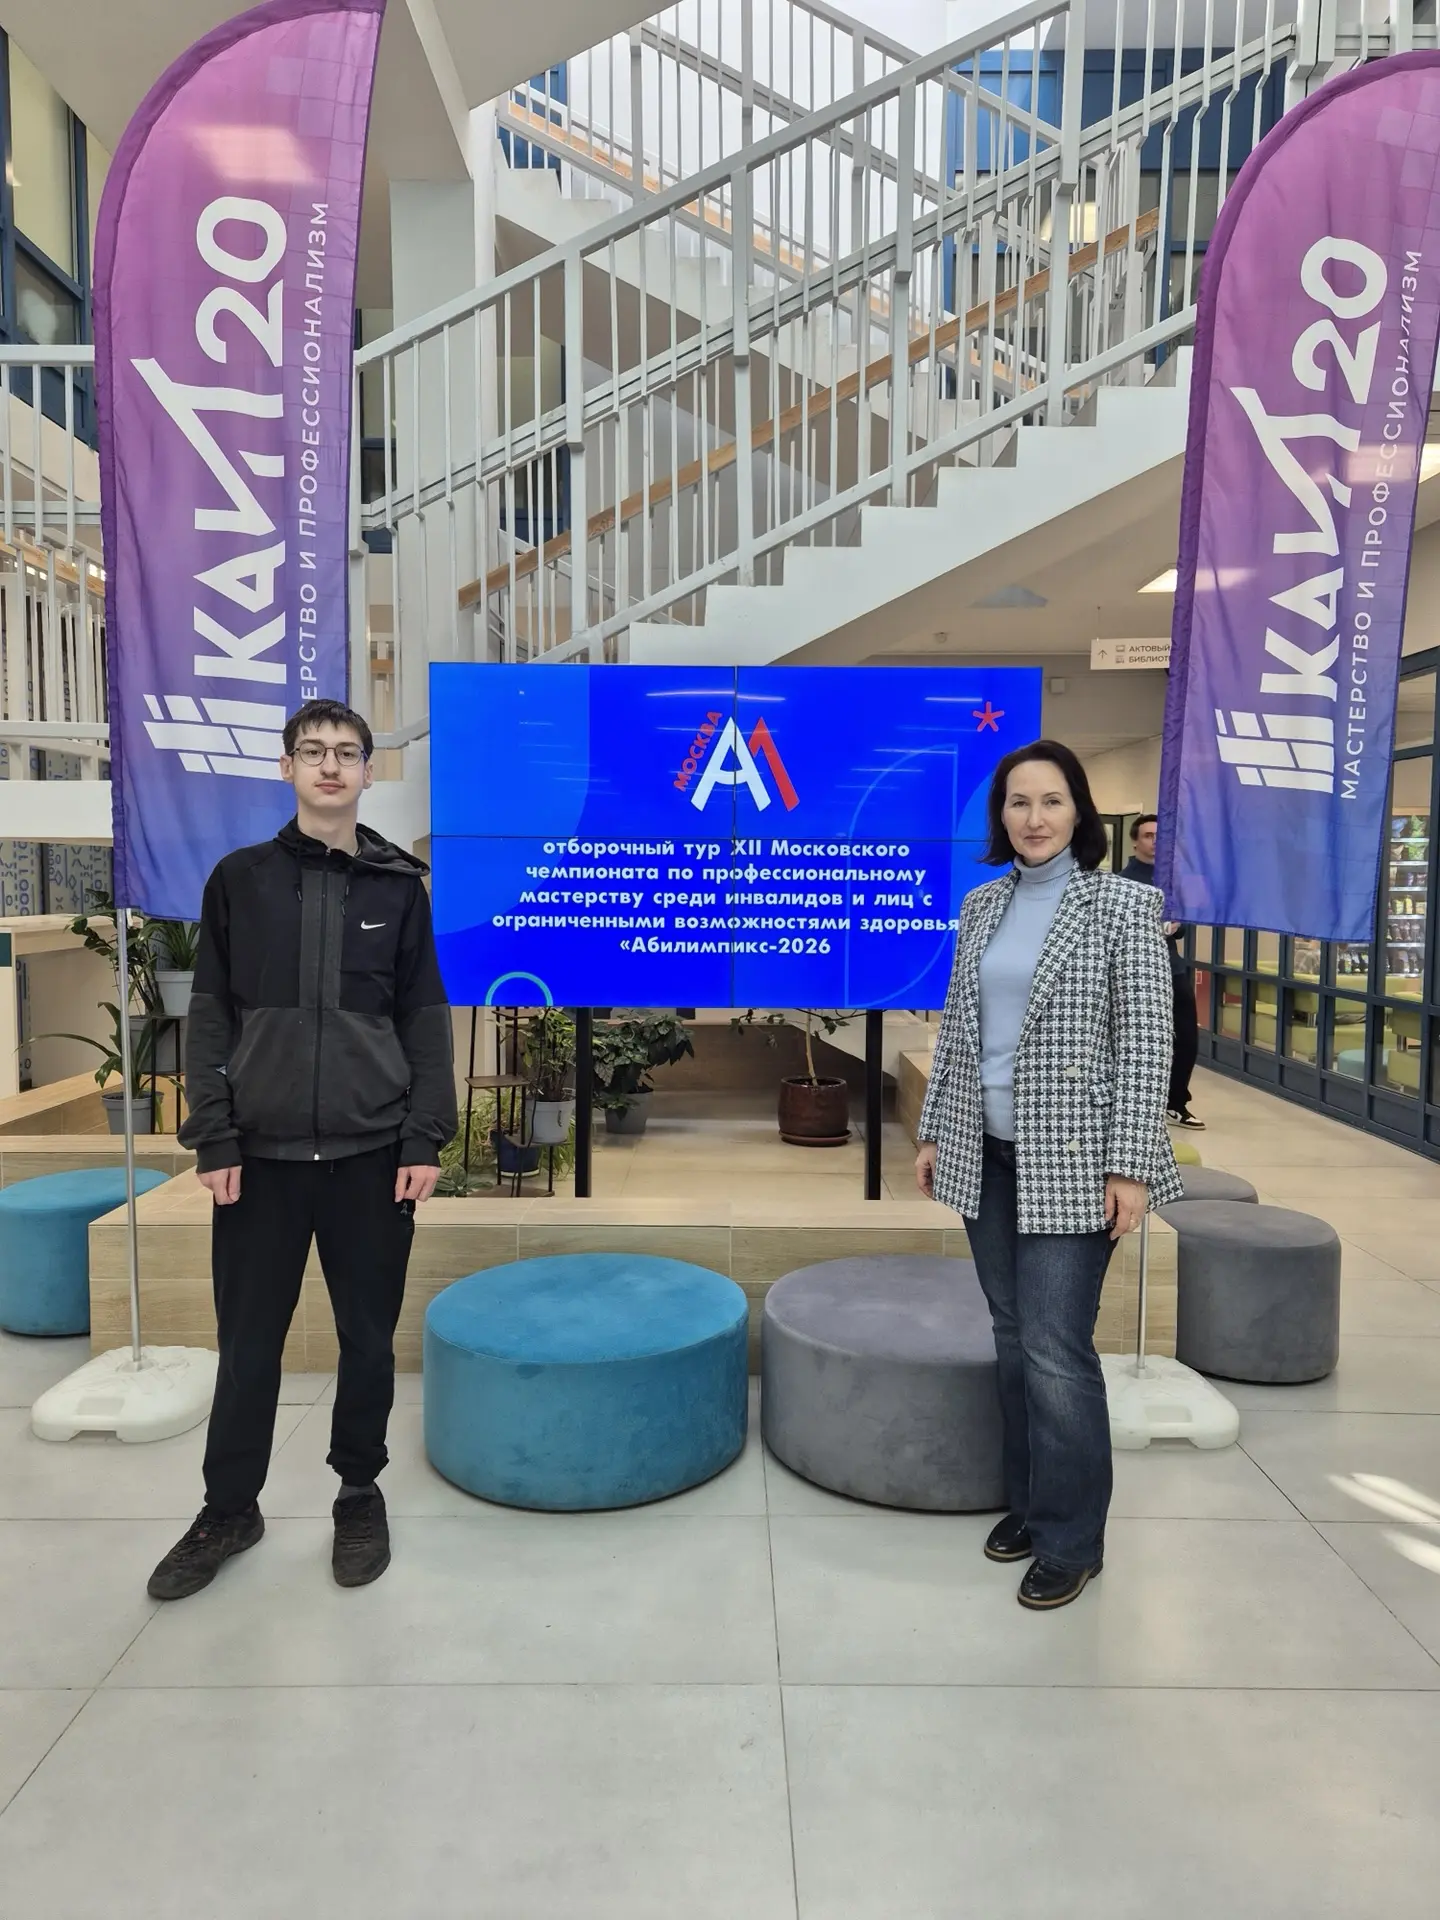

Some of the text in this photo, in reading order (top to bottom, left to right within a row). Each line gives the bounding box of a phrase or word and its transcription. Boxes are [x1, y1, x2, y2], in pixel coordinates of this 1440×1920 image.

[299, 202, 329, 708] ЕРСТВО И ПРОФЕССИОНАЛИЗМ
[1341, 250, 1422, 799] МАСТЕРСТВО И ПРОФЕССИОНАЛИЗМ
[673, 711, 722, 792] МОСКВА
[543, 838, 675, 859] отборочный
[684, 844, 721, 860] тур
[771, 840, 910, 858] Московского
[525, 863, 926, 885] чемпионата по профессиональному
[519, 890, 933, 909] мастерству среди инвалидов и лиц с
[492, 914, 960, 934] ограниченными возможностями здоровья
[620, 937, 831, 955] «Абилимпикс-2026
